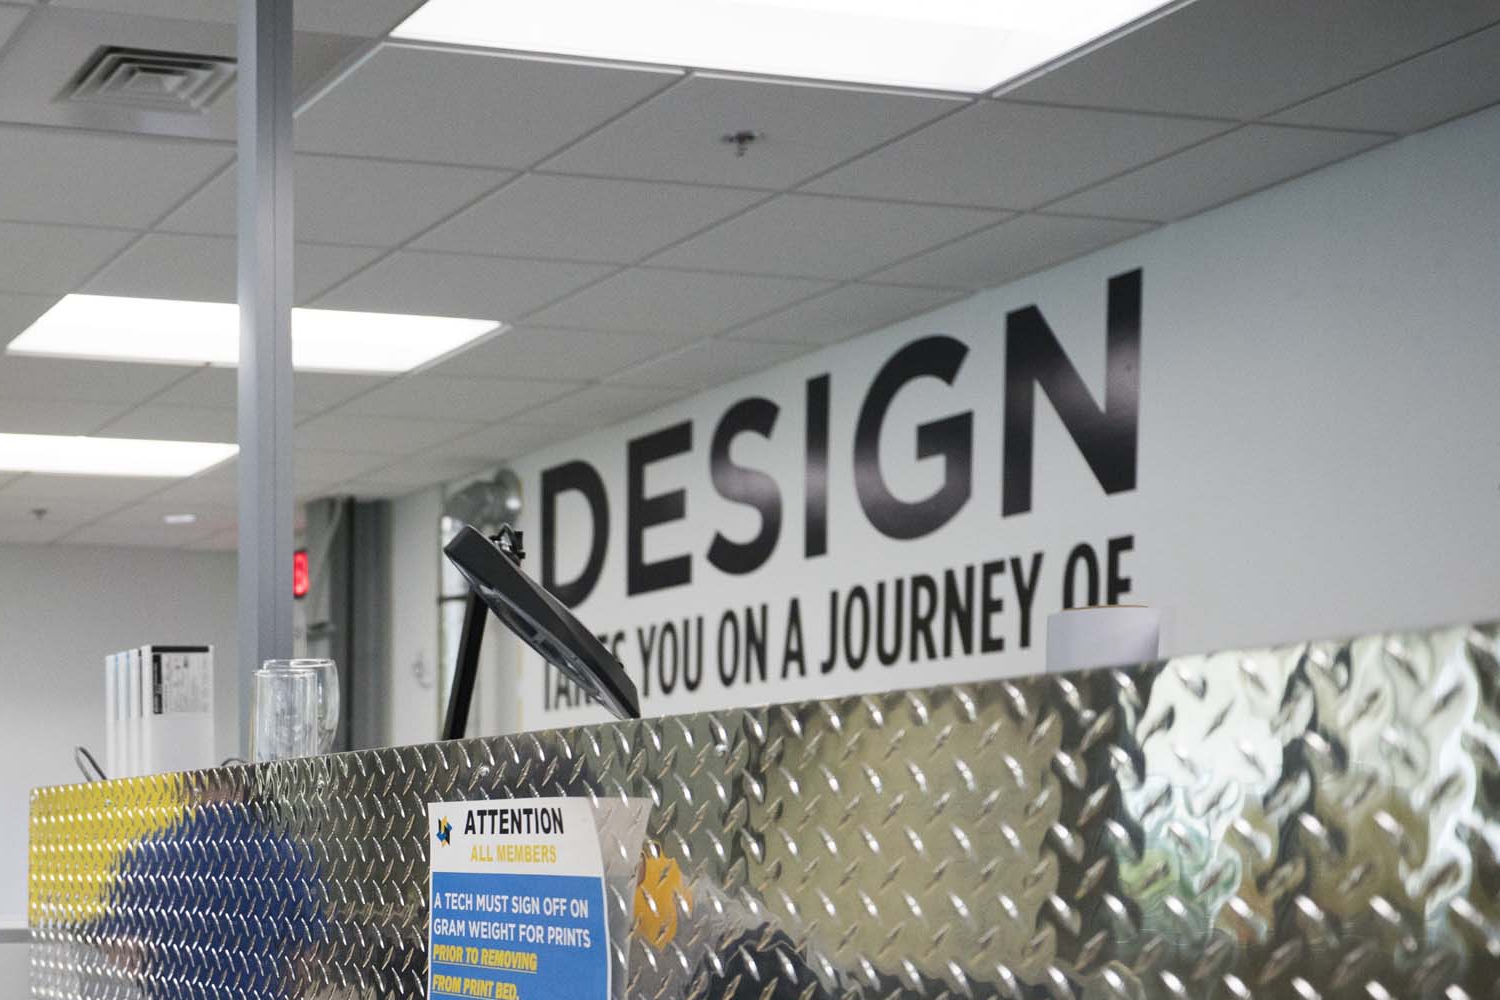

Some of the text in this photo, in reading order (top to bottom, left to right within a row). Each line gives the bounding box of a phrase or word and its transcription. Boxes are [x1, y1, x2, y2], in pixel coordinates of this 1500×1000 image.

[540, 267, 1143, 610] DESIGN
[637, 614, 704, 698] YOU
[717, 598, 769, 688] ON
[781, 598, 807, 680] A
[821, 552, 1044, 675] JOURNEY
[464, 808, 564, 834] ATTENTION
[470, 844, 557, 864] ALL MEMBERS
[434, 892, 589, 919] A TECH MUST SIGN OFF ON
[433, 918, 591, 949] GRAM WEIGHT FOR PRINTS
[433, 944, 538, 972] PRIOR TO REMOVING
[432, 975, 462, 994] FROM
[463, 977, 493, 997] PRINT
